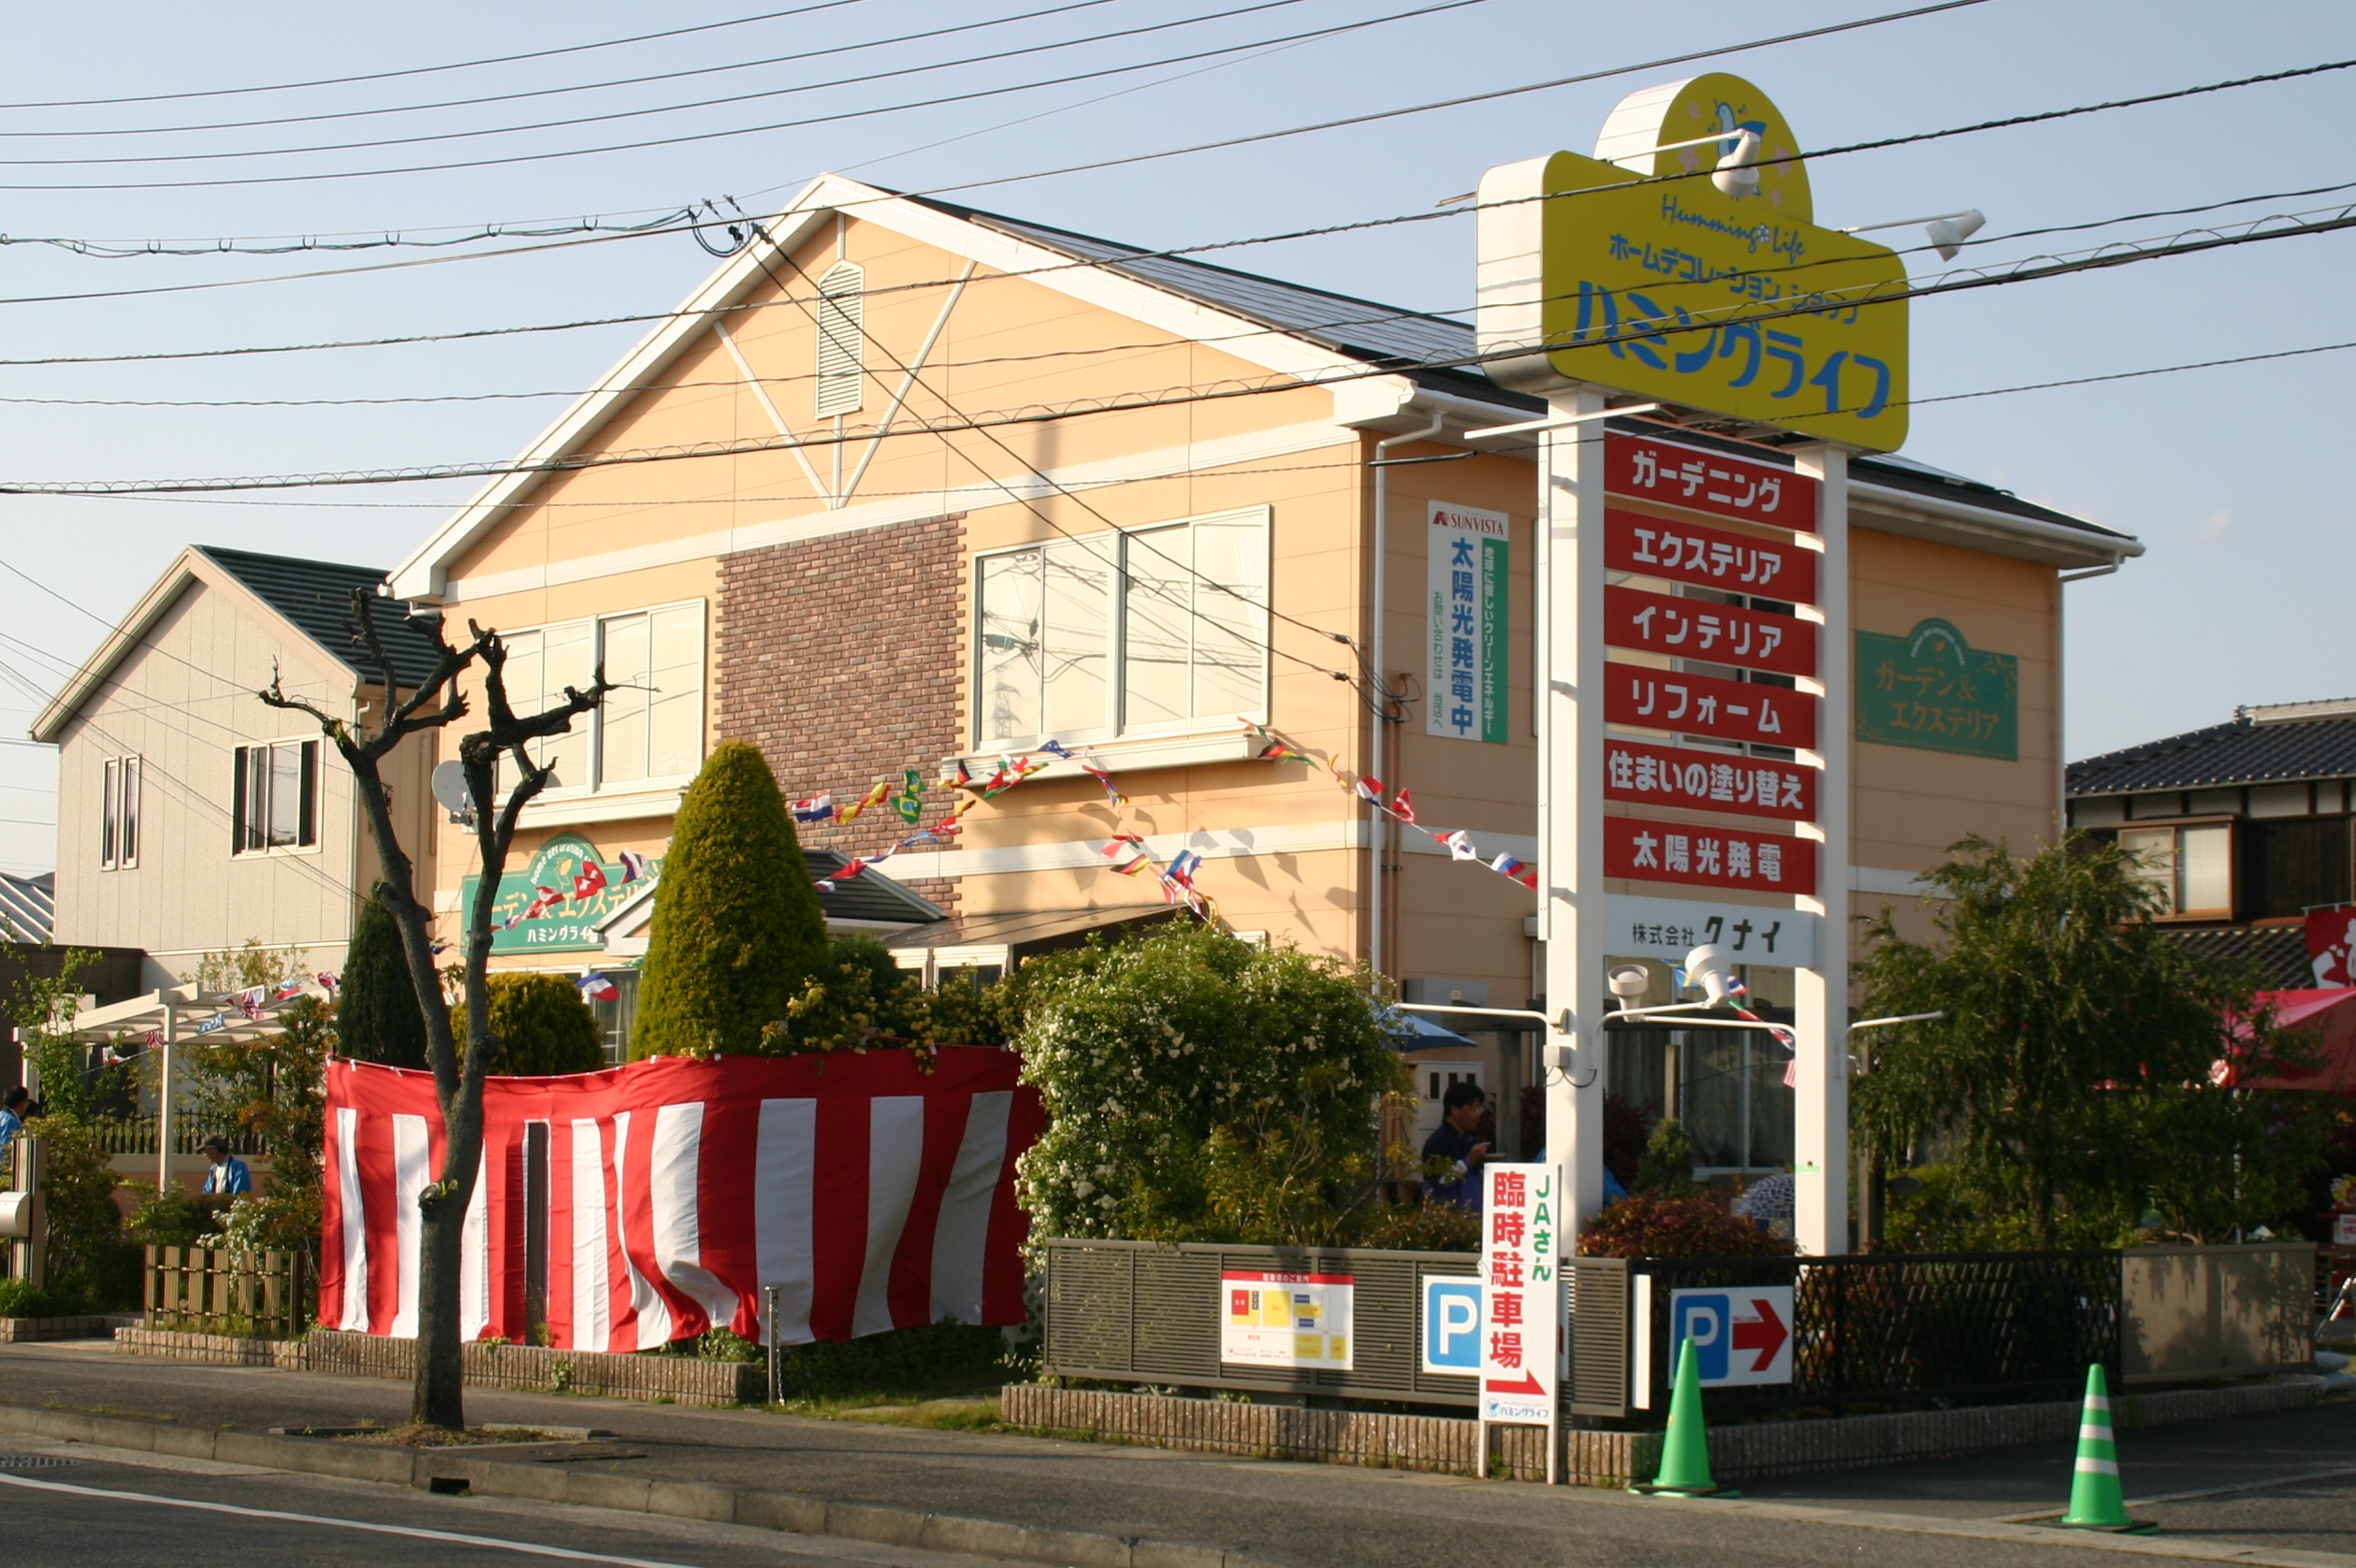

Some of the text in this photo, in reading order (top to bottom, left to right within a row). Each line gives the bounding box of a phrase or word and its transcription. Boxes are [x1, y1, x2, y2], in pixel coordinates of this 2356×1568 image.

[1662, 193, 1807, 265] Humming Life
[1609, 233, 1782, 301] ホームデコレーション
[1570, 280, 1890, 419] ハミングライフ
[1632, 450, 1782, 513] ガーデニング
[1451, 513, 1505, 536] SUNVISTA
[1632, 527, 1782, 585] エクステリア
[1451, 537, 1475, 736] 太陽光発電中
[1632, 605, 1782, 659] インテリア
[1632, 678, 1782, 734] リフォーム
[1890, 703, 2000, 741] エクステリア
[1607, 749, 1804, 810] 住まいの塗り替え
[1632, 830, 1782, 882] 太陽光発電
[1632, 915, 1782, 953] 株式会社 クナイ
[1532, 1174, 1552, 1283] JAさん
[1489, 1170, 1527, 1370] 臨時駐車場
[1439, 1294, 1479, 1356] P
[1685, 1306, 1720, 1351] P
